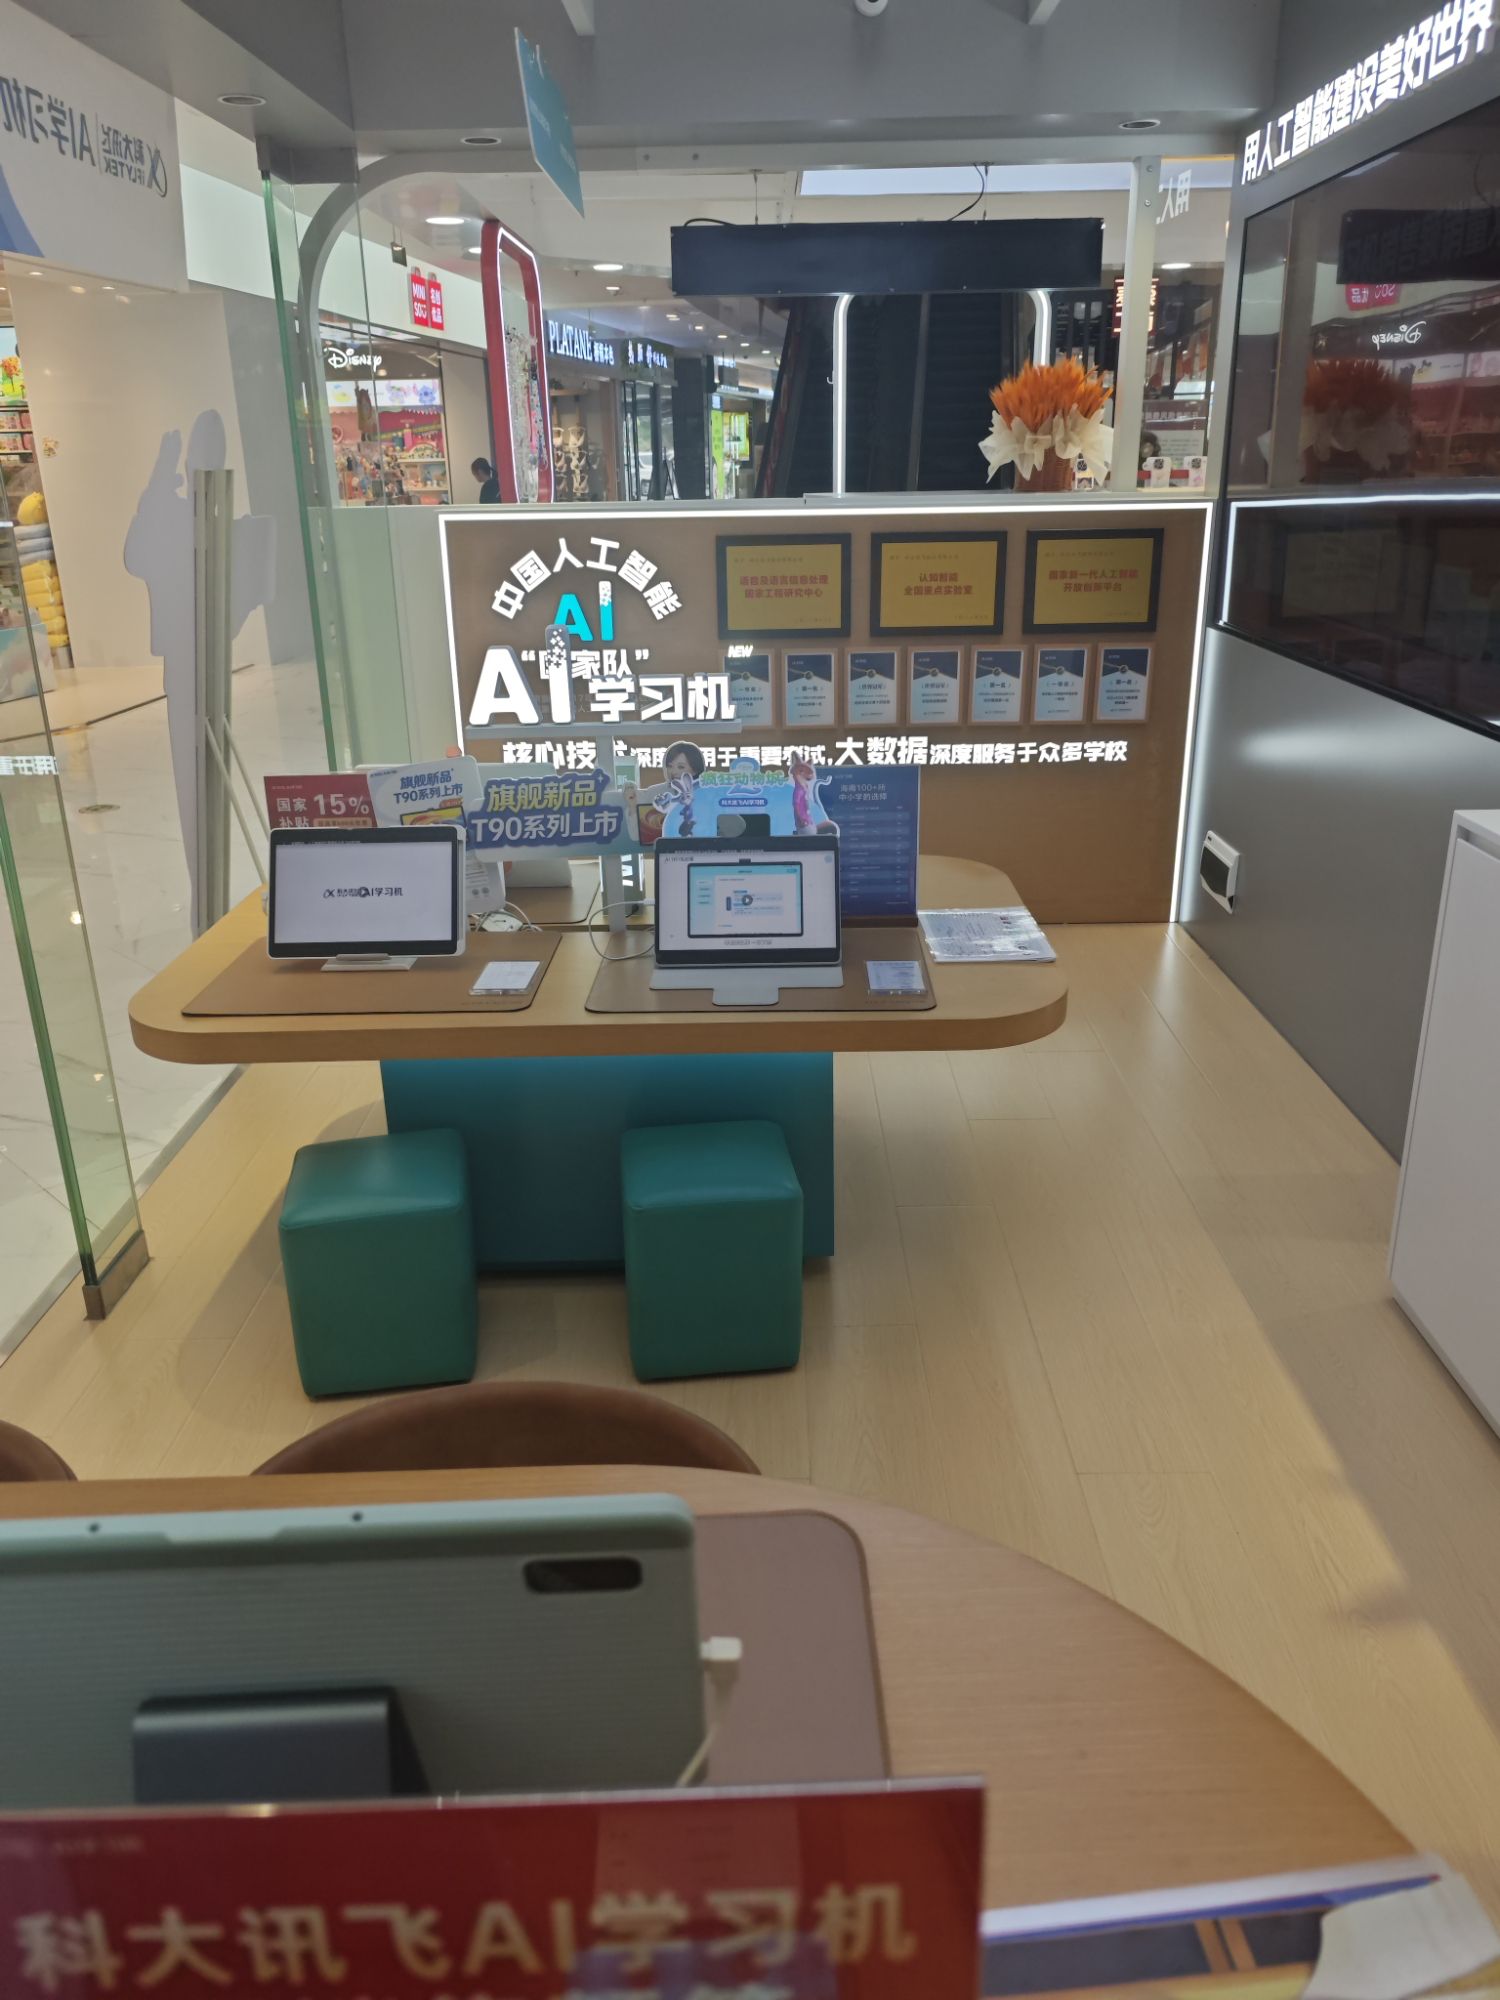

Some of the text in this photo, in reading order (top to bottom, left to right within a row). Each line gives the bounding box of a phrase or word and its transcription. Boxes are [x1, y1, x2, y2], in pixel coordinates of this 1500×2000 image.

[1242, 0, 1491, 184] 用人工智能建设美好世界
[412, 282, 426, 300] MINI
[491, 536, 682, 621] 中国人工智能
[553, 580, 615, 642] AI
[521, 648, 650, 680] “家队”
[727, 645, 754, 658] NEW
[468, 624, 736, 726] AI学习机
[393, 783, 463, 804] T90系列上市
[400, 769, 452, 789] 旗舰新品
[277, 797, 308, 813] 国家
[313, 793, 370, 816] 15%
[486, 779, 597, 813] 旗舰新品
[471, 810, 619, 843] T90系列上市
[14, 1883, 916, 1991] 科大讯飞AI学习机
